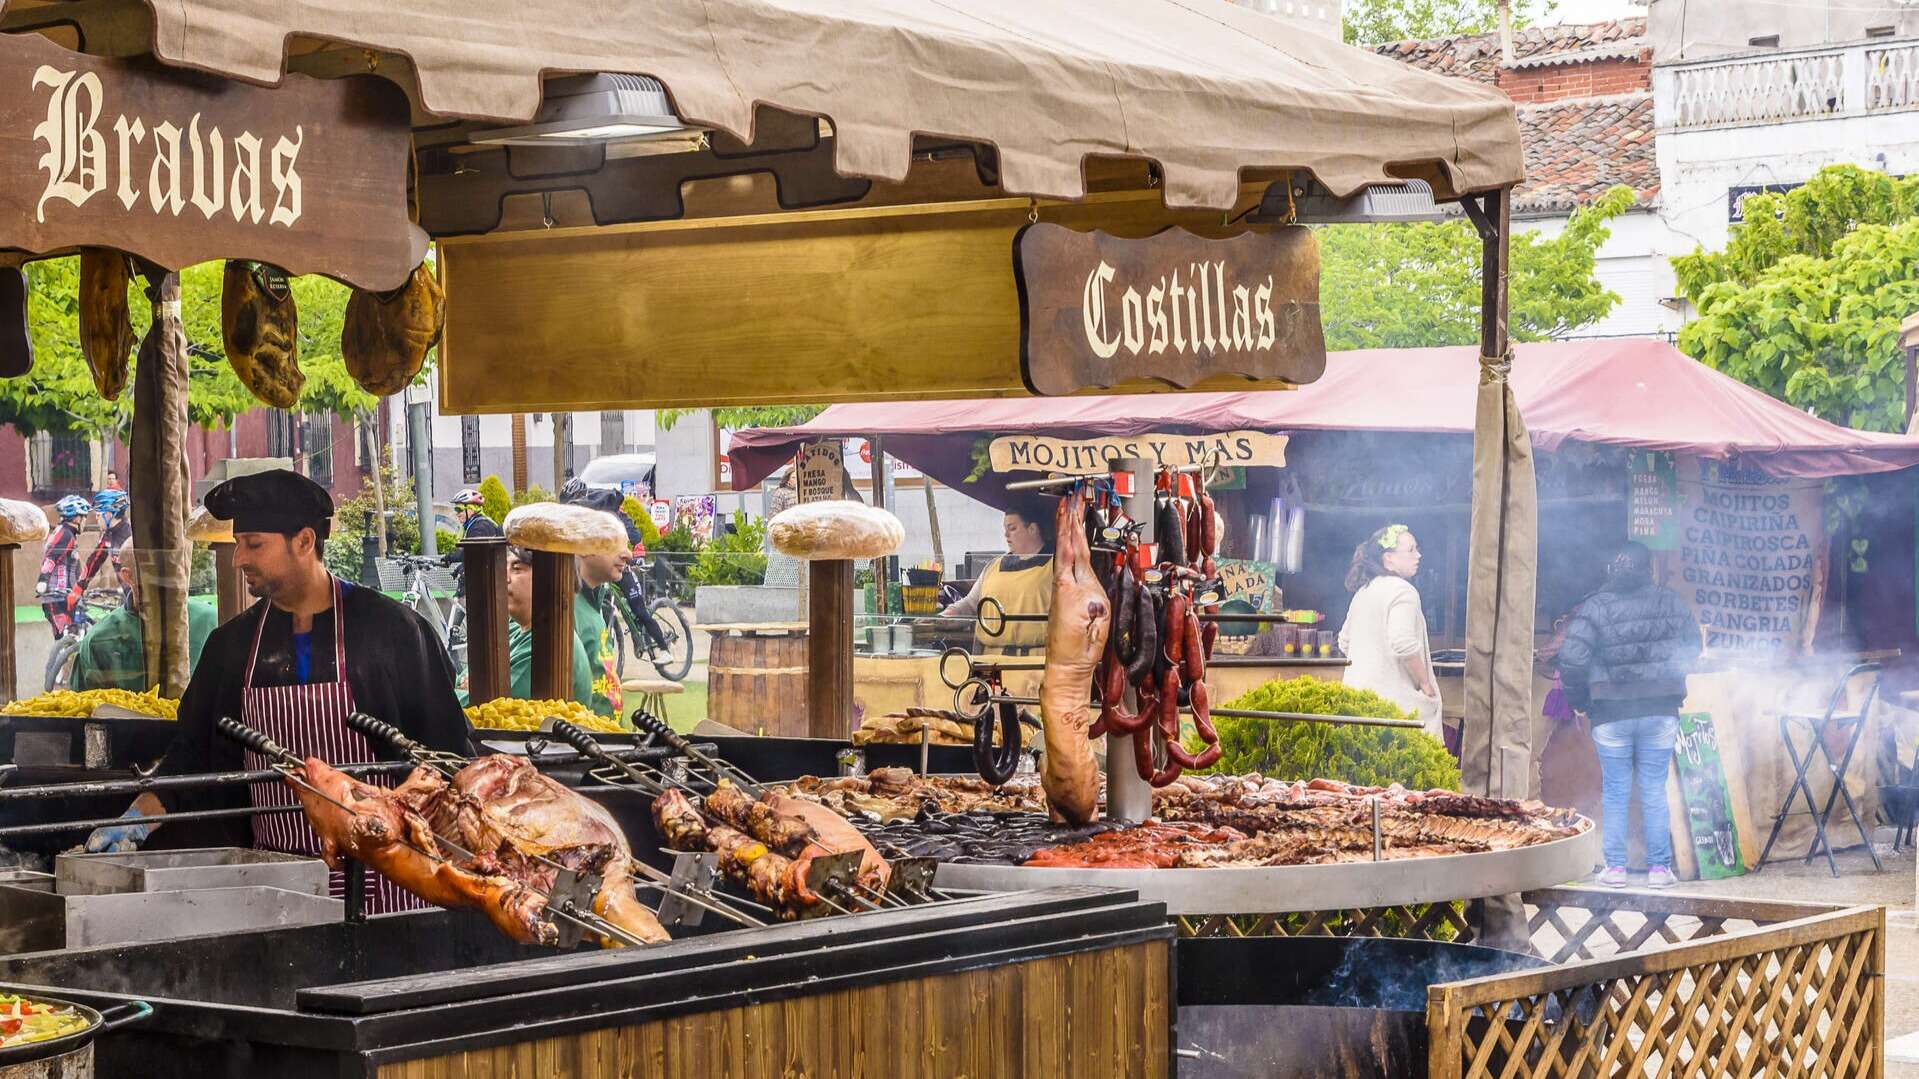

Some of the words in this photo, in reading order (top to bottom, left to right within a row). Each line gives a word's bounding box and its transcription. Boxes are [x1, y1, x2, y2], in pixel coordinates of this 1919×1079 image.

[32, 64, 304, 229] Bravas
[1083, 260, 1276, 359] Costillas
[1008, 441, 1141, 470] MOJITOS
[1148, 442, 1168, 467] Y
[803, 469, 826, 479] FRESA
[803, 478, 827, 487] MANGO
[808, 487, 834, 496] BOSQUE
[1703, 489, 1791, 512] MOJITOS
[1694, 507, 1800, 532] CAIPIRIÑA
[1685, 527, 1811, 552] CAIPIROSCA
[1681, 545, 1730, 567] PIÑA
[1734, 552, 1814, 572] COLADA
[1682, 567, 1812, 592] GRANIZADOS
[1695, 589, 1800, 613] SORBETES
[1700, 608, 1792, 633] SANGRIA
